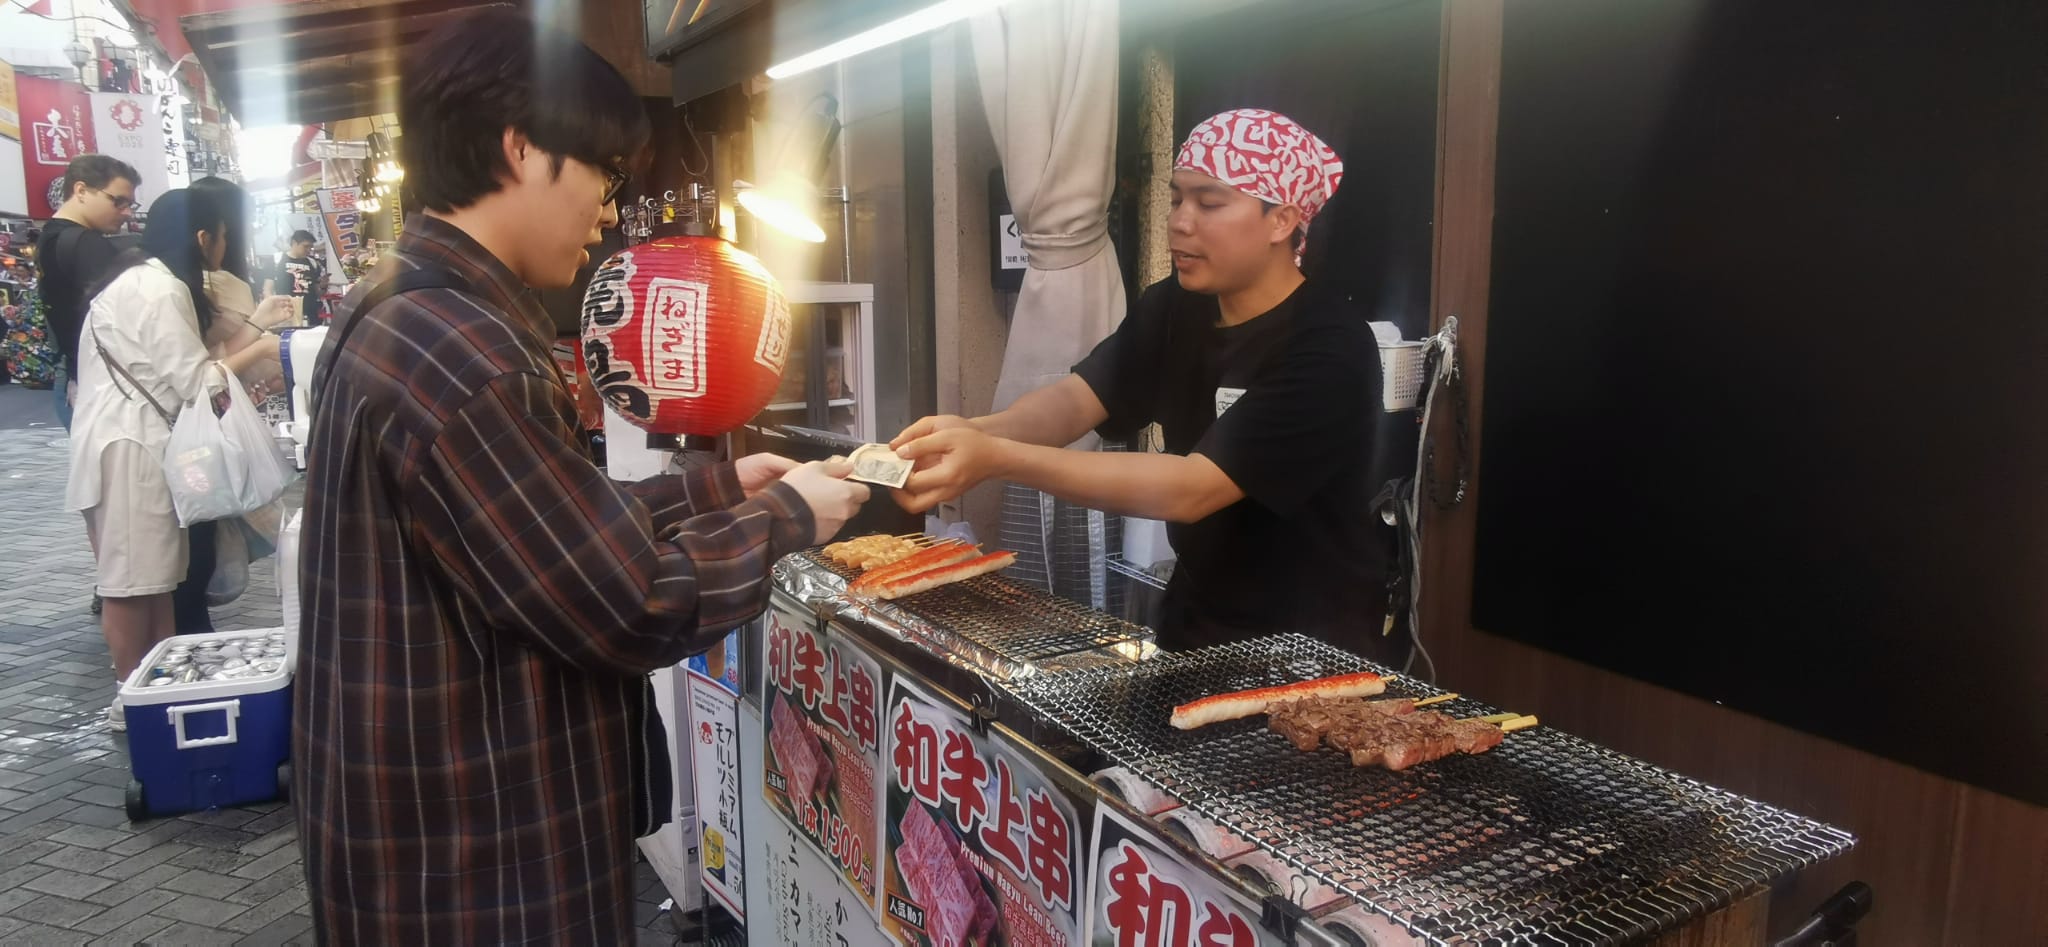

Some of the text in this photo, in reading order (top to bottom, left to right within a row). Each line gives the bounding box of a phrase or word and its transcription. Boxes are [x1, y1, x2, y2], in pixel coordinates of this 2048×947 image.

[660, 295, 692, 382] ねぎま
[769, 614, 877, 751] 和牛上串
[806, 716, 831, 741] Premium
[725, 727, 738, 840] プレミアム
[893, 702, 1070, 909] 和牛上串
[889, 897, 923, 927] 人気No.1
[960, 840, 1066, 947] Premium Wagyu Lean Beef
